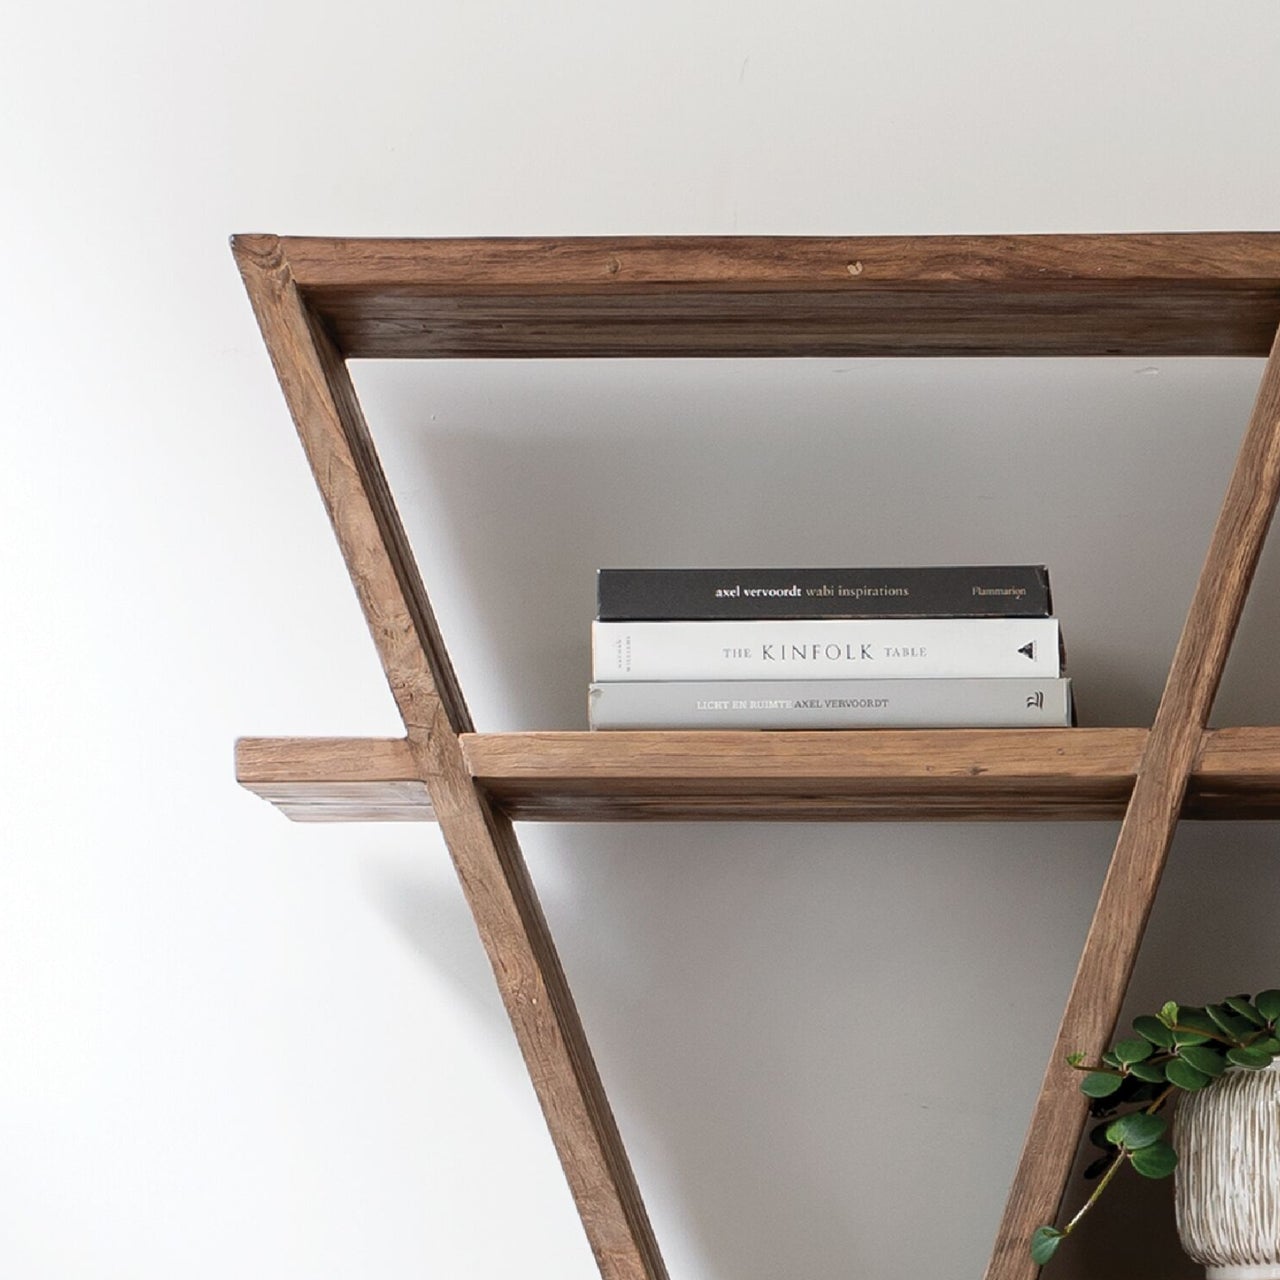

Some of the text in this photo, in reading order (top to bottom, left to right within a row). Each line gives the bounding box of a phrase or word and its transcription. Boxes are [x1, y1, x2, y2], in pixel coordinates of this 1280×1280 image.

[715, 585, 910, 600] axel vervoordt wabi inspirations
[722, 644, 928, 661] THE KINFOLK TABLE
[732, 700, 747, 710] EN
[794, 699, 821, 709] AXEL
[824, 698, 889, 709] VERVOORDT
